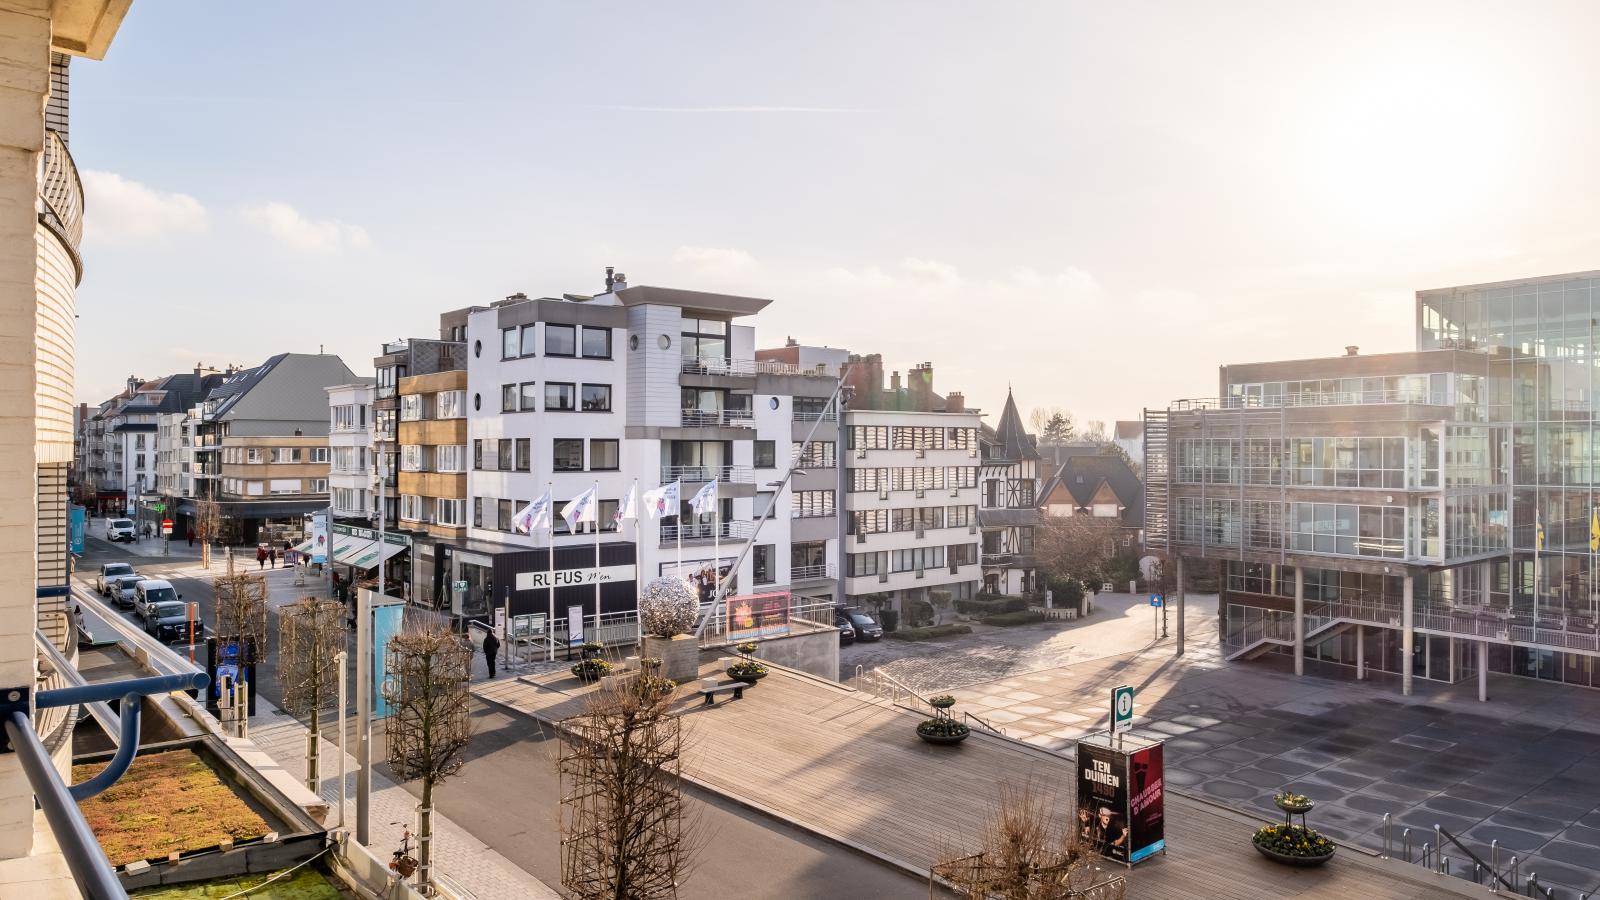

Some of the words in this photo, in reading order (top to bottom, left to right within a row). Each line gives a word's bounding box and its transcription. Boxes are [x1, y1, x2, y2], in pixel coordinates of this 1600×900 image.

[533, 571, 583, 587] RUFUS
[1092, 759, 1111, 774] TEN
[1084, 768, 1120, 788] DUINEN
